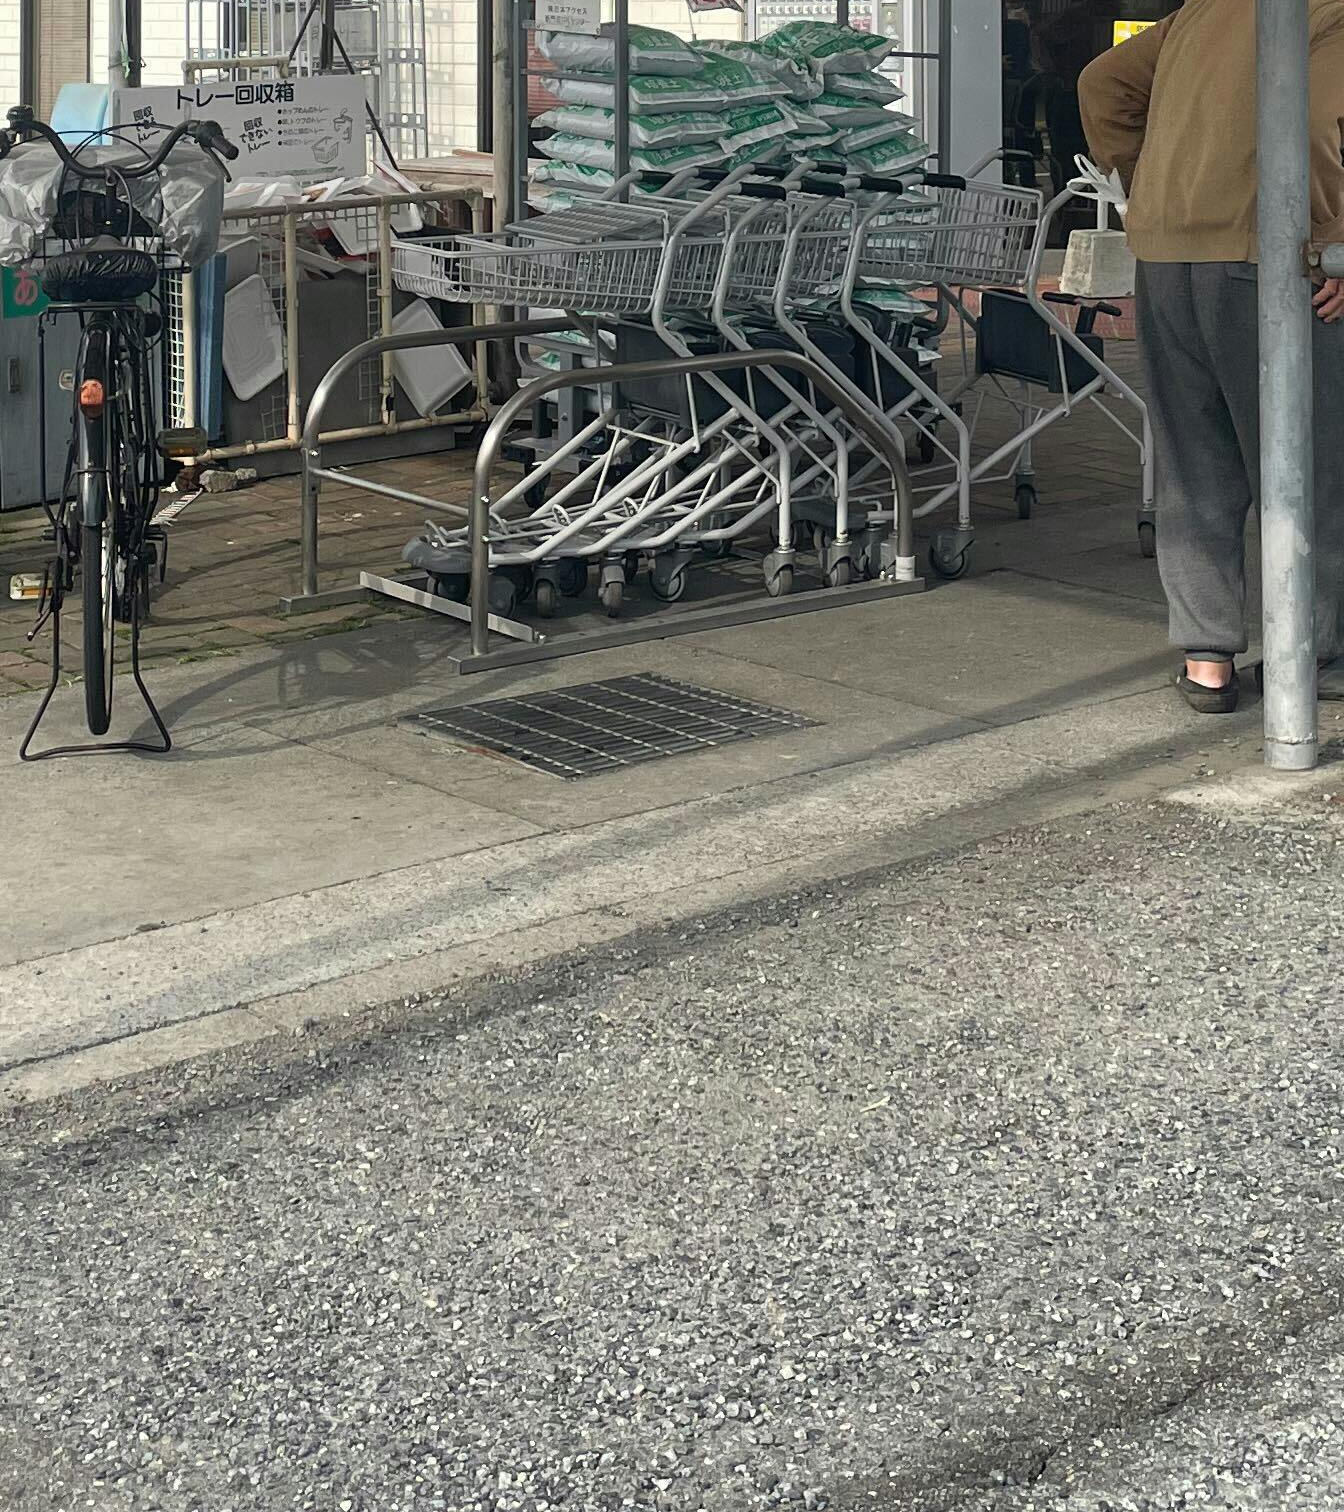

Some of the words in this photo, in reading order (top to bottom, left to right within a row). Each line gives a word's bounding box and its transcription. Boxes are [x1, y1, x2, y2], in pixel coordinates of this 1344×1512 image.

[176, 82, 295, 110] トレー回収箱
[244, 117, 263, 131] 回収
[239, 127, 274, 144] できない
[247, 139, 272, 154] トレー
